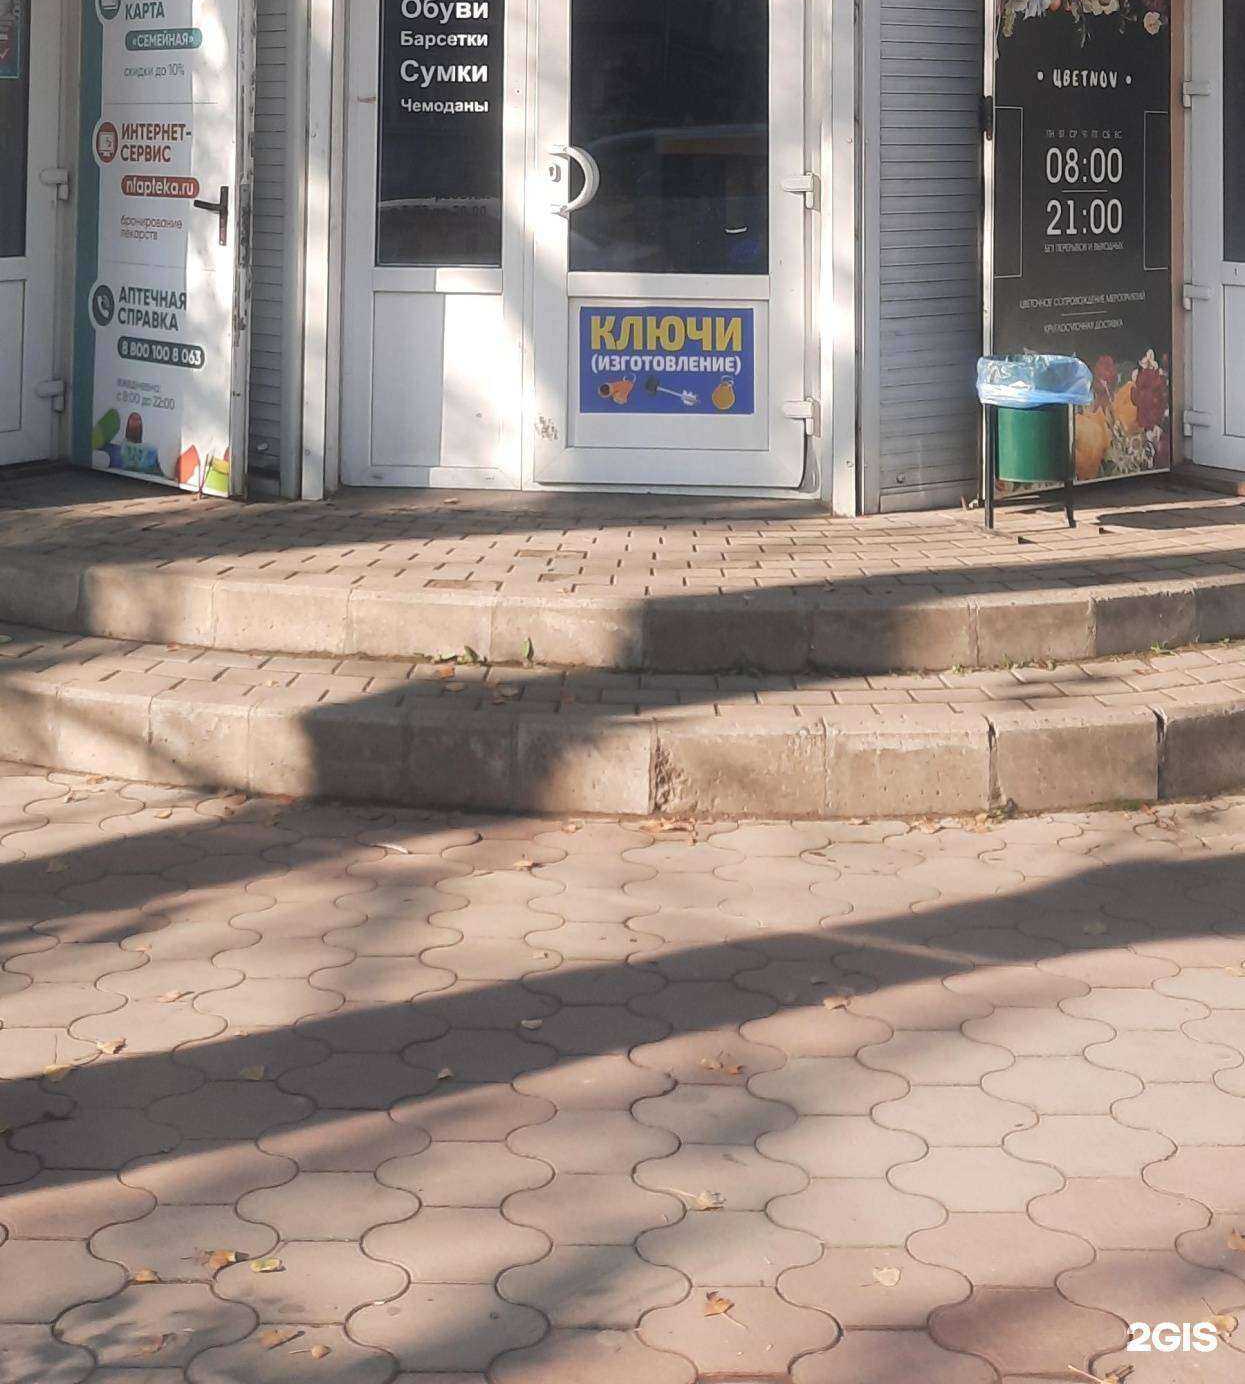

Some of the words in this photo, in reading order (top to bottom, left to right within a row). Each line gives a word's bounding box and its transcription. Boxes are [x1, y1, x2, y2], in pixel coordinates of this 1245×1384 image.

[125, 2, 165, 20] КАРТА
[400, 31, 488, 49] Барсетки
[400, 59, 488, 87] Сумки
[401, 98, 489, 114] Чемоданы
[121, 123, 192, 141] ИНТЕРНЕТ-
[120, 144, 171, 162] СЕРВИС
[1046, 147, 1123, 183] 08:00
[1046, 199, 1122, 235] 21:00
[119, 286, 187, 311] АПТЕЧНАЯ
[118, 307, 179, 331] СПРАВКА
[591, 315, 742, 352] КЛЮЧИ
[121, 341, 128, 355] 8
[130, 342, 150, 358] 800
[151, 345, 170, 361] 100
[172, 348, 179, 362] 8
[181, 349, 202, 366] 063
[591, 354, 742, 375] (ИЗГОТОВЛЕНИЕ)
